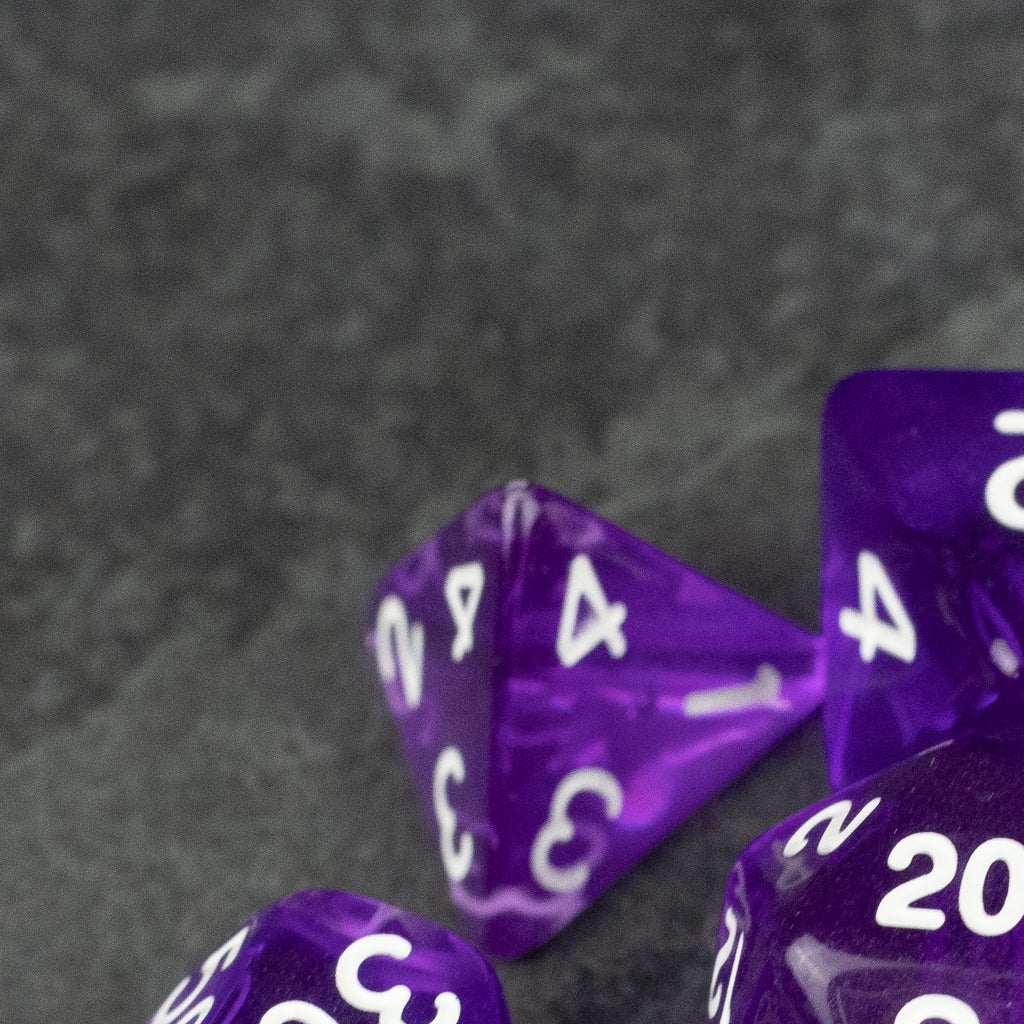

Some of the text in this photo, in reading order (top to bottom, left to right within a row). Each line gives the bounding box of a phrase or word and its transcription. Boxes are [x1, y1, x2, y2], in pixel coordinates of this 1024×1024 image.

[557, 555, 626, 667] 4
[839, 552, 916, 662] 4
[531, 767, 623, 893] 3
[783, 797, 881, 858] 2
